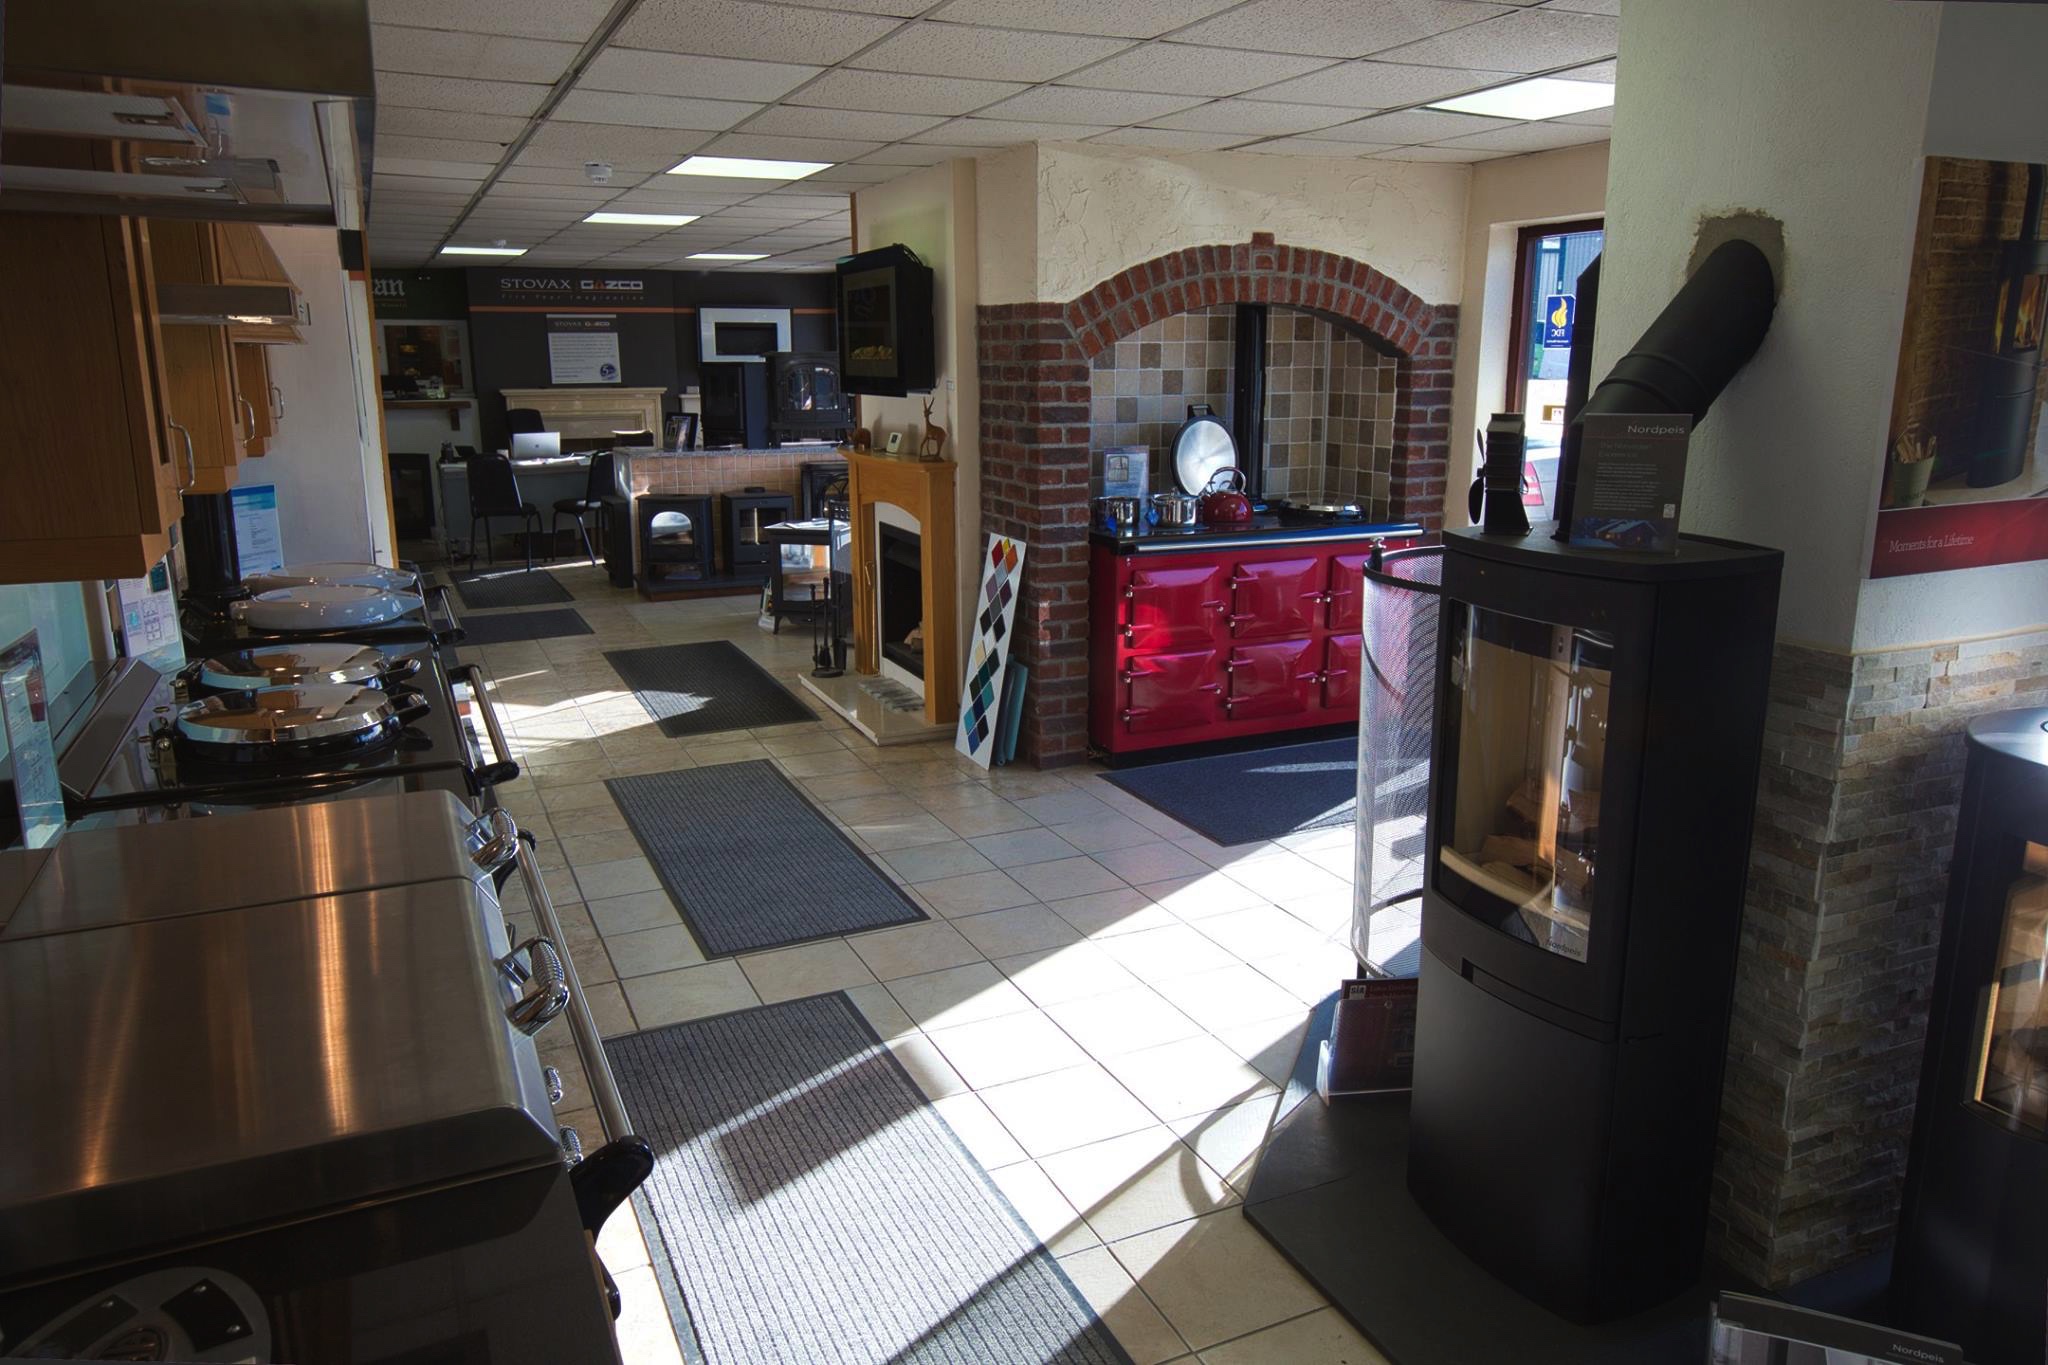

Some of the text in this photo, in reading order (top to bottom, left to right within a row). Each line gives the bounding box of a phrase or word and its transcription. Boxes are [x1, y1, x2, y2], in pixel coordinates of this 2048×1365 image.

[500, 278, 644, 290] STOVAX GAZCO
[1627, 425, 1685, 435] Nordpeis
[1889, 539, 1926, 552] Moments
[1926, 535, 1939, 549] for
[1944, 533, 1974, 547] Lifetime
[1892, 1343, 1945, 1364] Nordpeis
